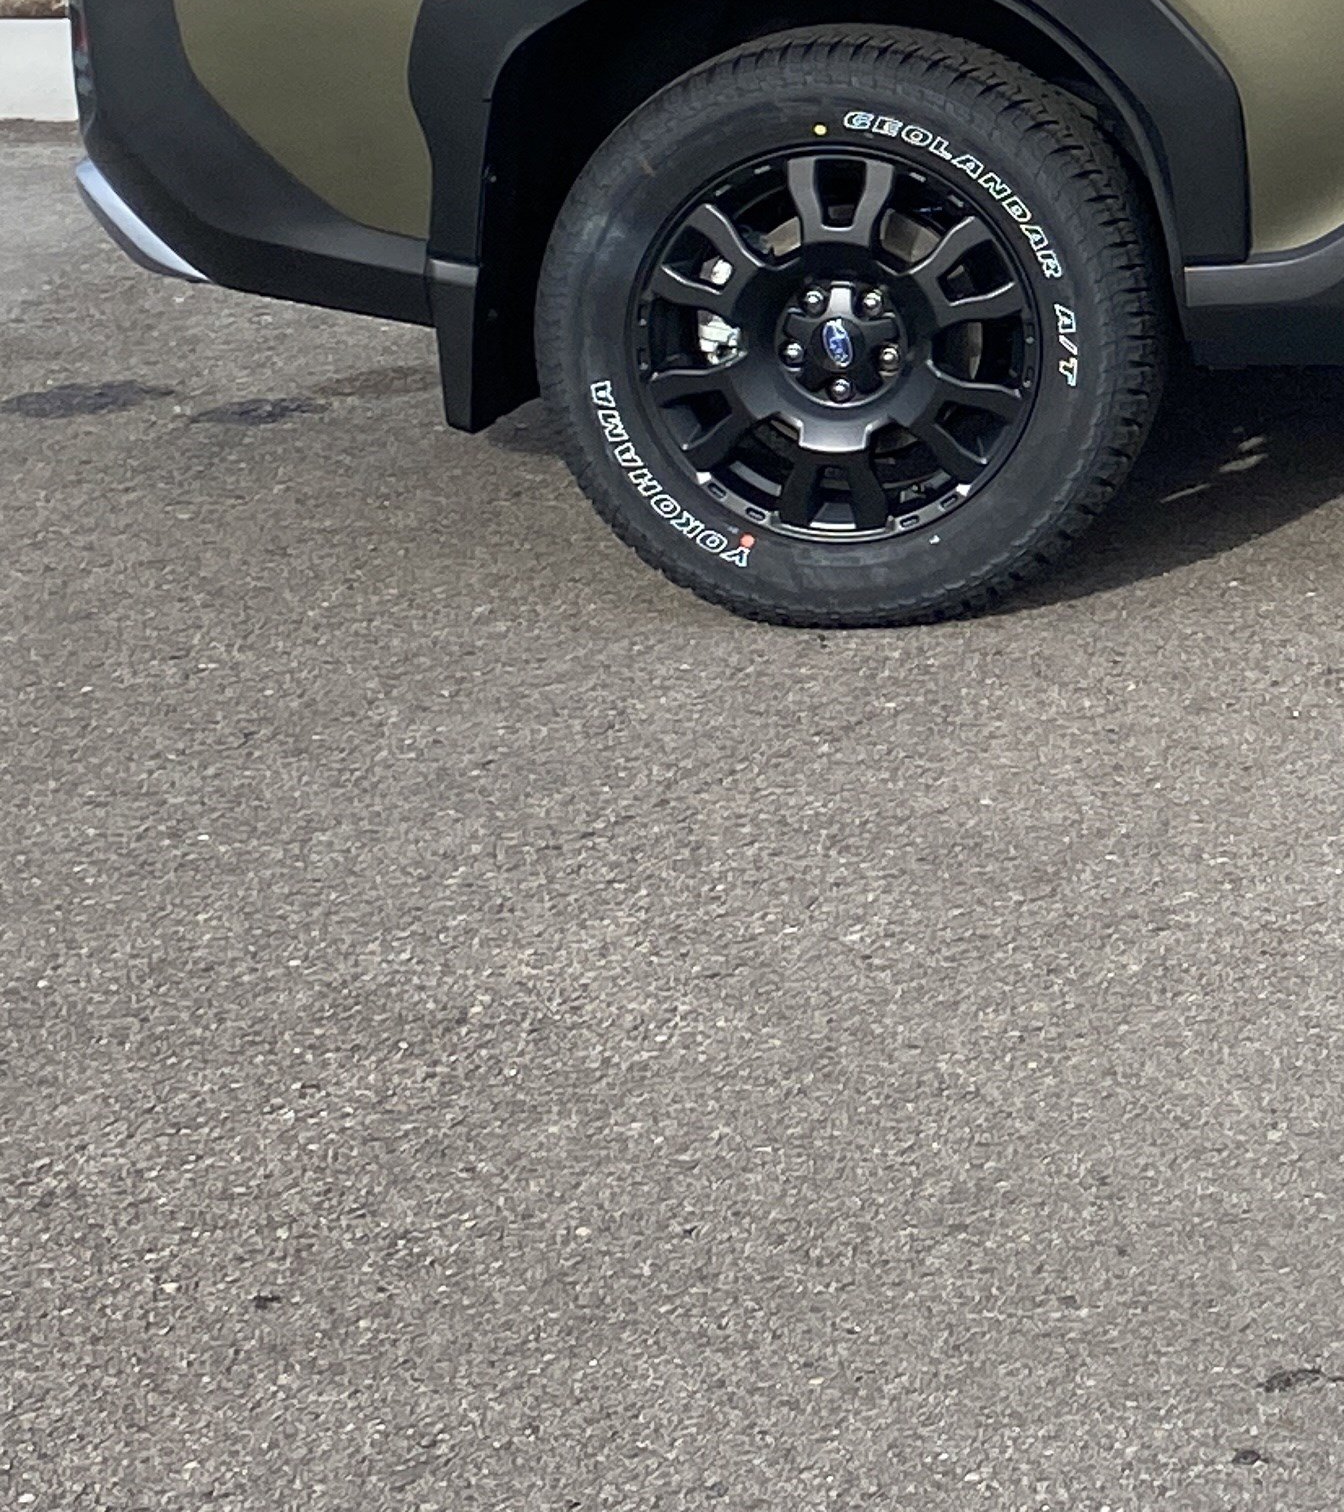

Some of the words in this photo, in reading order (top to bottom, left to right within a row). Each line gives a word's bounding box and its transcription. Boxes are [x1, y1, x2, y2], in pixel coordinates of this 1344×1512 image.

[844, 111, 1062, 278] GEOLANDAR
[1054, 304, 1078, 386] A/T
[590, 380, 751, 567] YOKOHAMA
